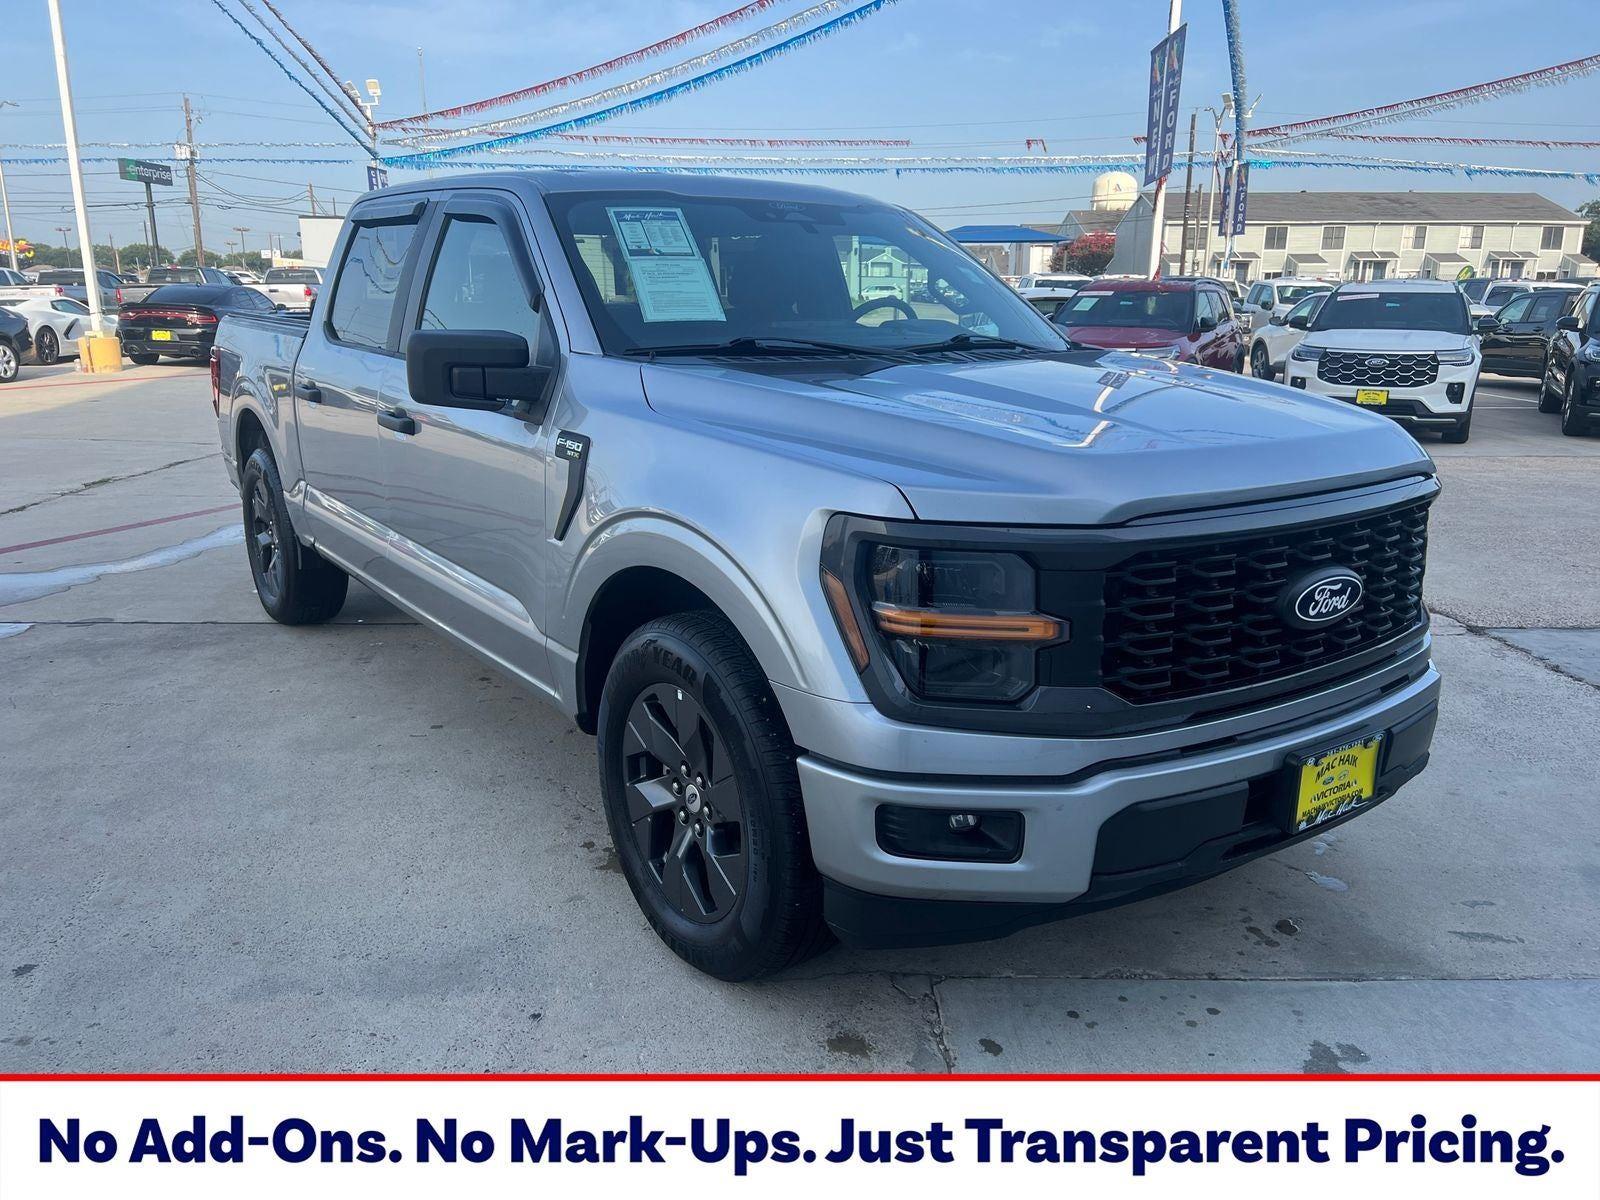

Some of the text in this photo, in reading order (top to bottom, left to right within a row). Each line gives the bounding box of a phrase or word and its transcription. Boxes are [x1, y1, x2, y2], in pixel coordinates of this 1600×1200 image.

[1162, 88, 1177, 170] FORD
[127, 164, 172, 180] enterprise
[1236, 192, 1245, 233] FORD
[556, 437, 583, 452] F-150
[1309, 583, 1351, 616] Ford
[1315, 754, 1359, 783] MAC HAIK
[1316, 781, 1354, 801] VICTORIA
